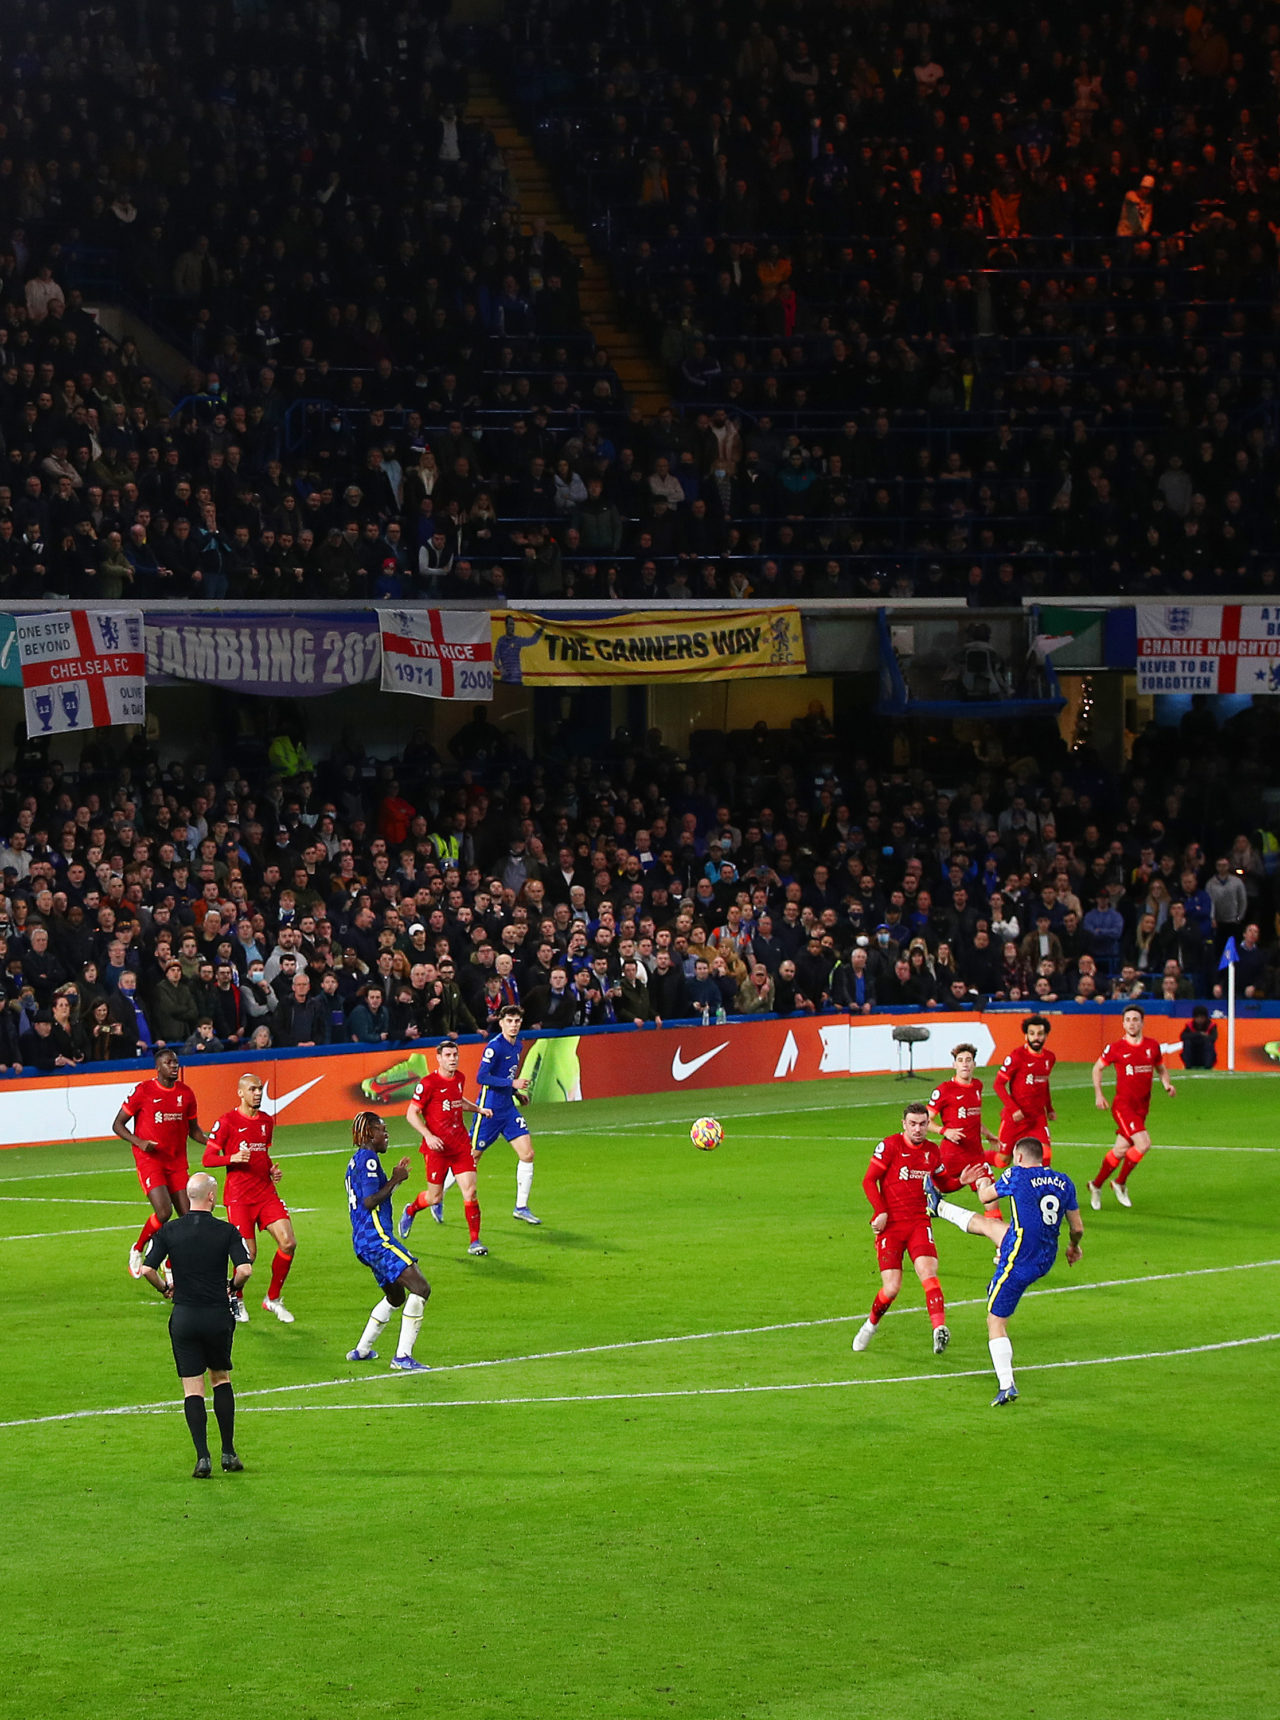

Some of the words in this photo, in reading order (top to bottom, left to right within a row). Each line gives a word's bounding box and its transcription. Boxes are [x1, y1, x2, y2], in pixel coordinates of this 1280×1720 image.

[19, 625, 42, 639] ONE
[45, 622, 70, 636] STEP
[25, 639, 71, 656] BEYOND
[410, 640, 439, 657] TIM
[440, 643, 475, 660] RICE
[544, 634, 595, 662] THE
[594, 633, 709, 662] CANNERS
[711, 626, 762, 656] WAY
[1142, 639, 1203, 655] CHARLIE
[1207, 640, 1280, 656] NAUGHTO
[50, 659, 112, 679] CHELSEA
[114, 658, 129, 673] FC
[1139, 660, 1176, 673] NEVER
[1181, 660, 1196, 673] TO
[1199, 660, 1215, 673] BE
[1142, 676, 1211, 690] FORGOTTEN
[65, 701, 76, 710] 21
[1040, 1195, 1060, 1226] 8
